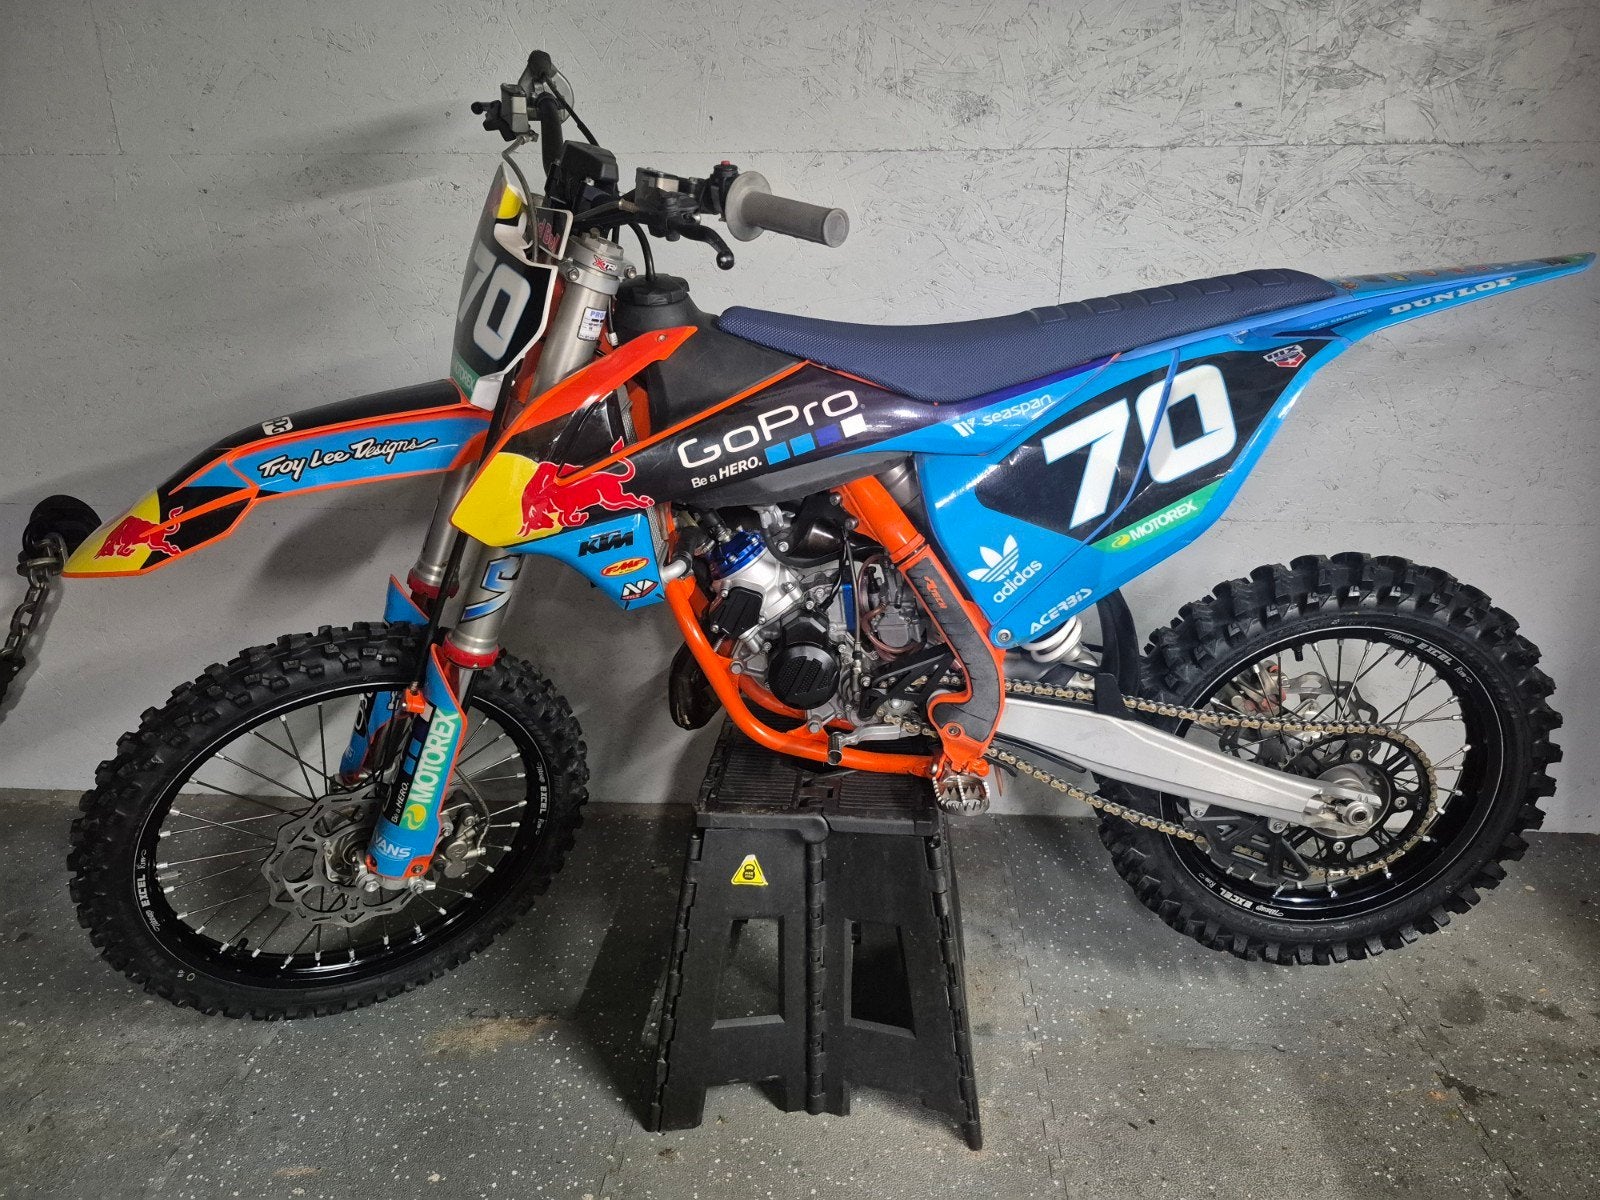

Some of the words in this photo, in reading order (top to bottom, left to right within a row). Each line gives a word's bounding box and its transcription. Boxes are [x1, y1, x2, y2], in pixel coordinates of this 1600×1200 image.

[458, 238, 531, 361] 70
[1389, 276, 1518, 315] DUNLOP
[982, 394, 1052, 427] seaspan
[677, 390, 859, 469] GoPro
[1041, 364, 1238, 530] 70
[258, 455, 307, 480] Troy
[309, 450, 350, 468] Lee
[350, 438, 438, 464] Designs
[691, 477, 708, 489] Be
[709, 474, 718, 483] a
[718, 456, 763, 480] HERO.
[1128, 500, 1199, 541] MOTOREX
[578, 529, 635, 557] KTM
[603, 558, 647, 575] FMF
[993, 560, 1043, 603] adidas
[1416, 642, 1454, 666] EXCEL
[408, 708, 460, 804] MOTOREX
[395, 782, 410, 808] HERO.
[539, 785, 548, 815] EXCEL
[136, 873, 151, 908] EXCEL
[1220, 887, 1254, 909] EXCEL
